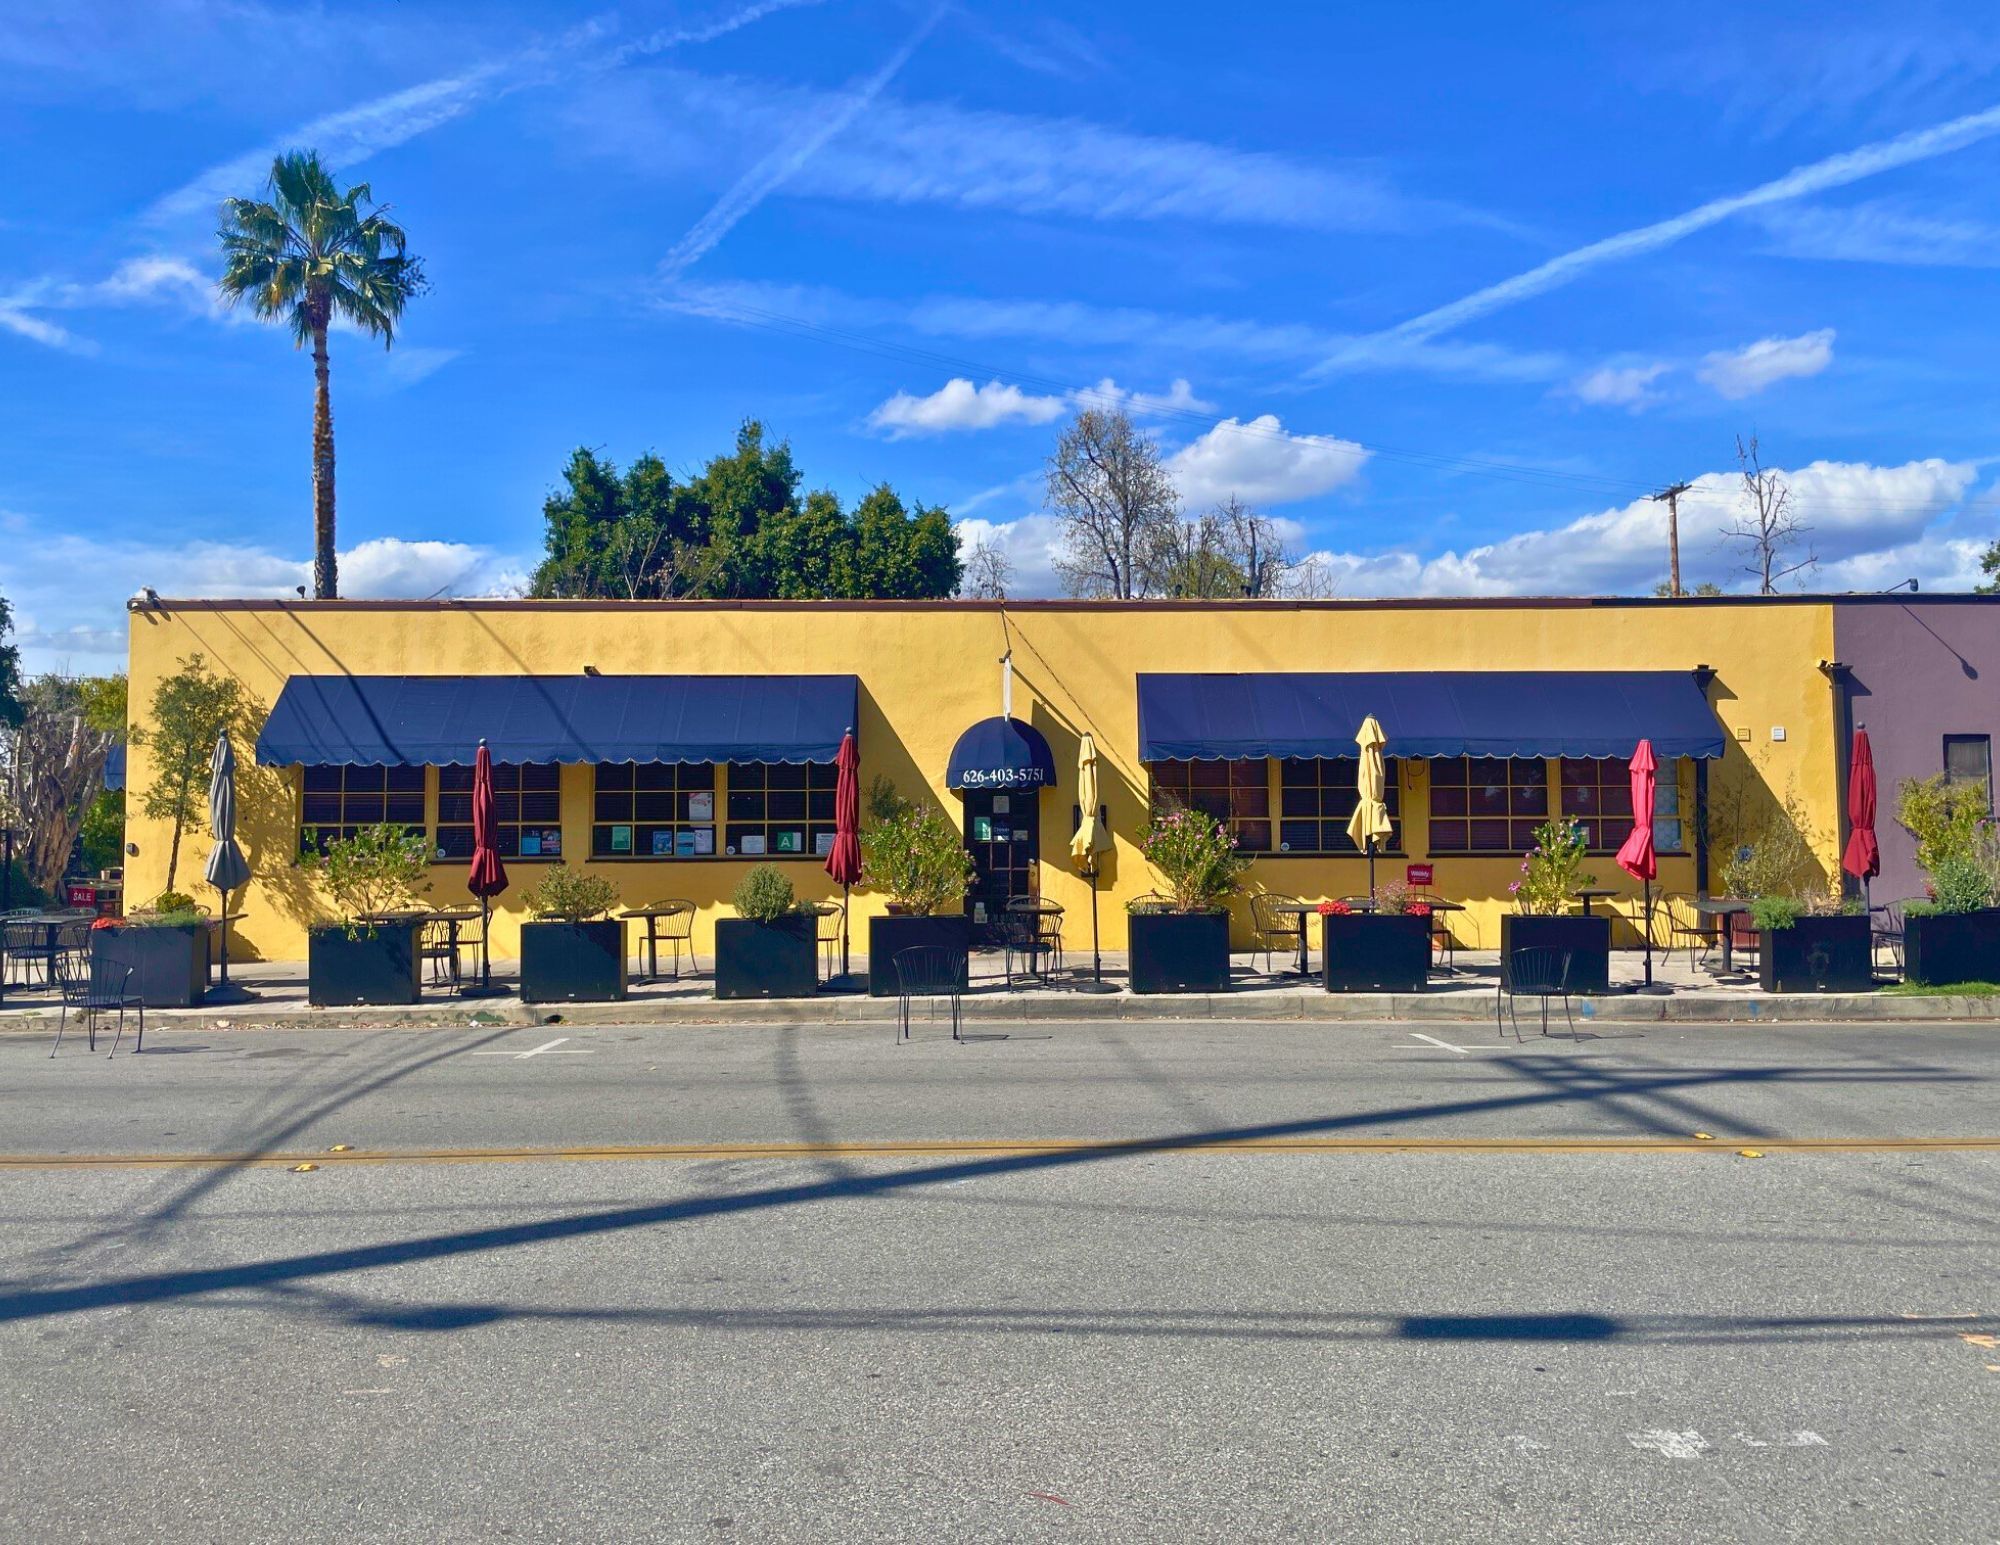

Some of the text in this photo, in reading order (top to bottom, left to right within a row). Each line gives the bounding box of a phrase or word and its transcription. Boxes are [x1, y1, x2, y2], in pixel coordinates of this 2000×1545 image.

[963, 768, 1044, 783] 626-403-5751
[780, 836, 791, 848] A
[73, 892, 92, 901] SALE
